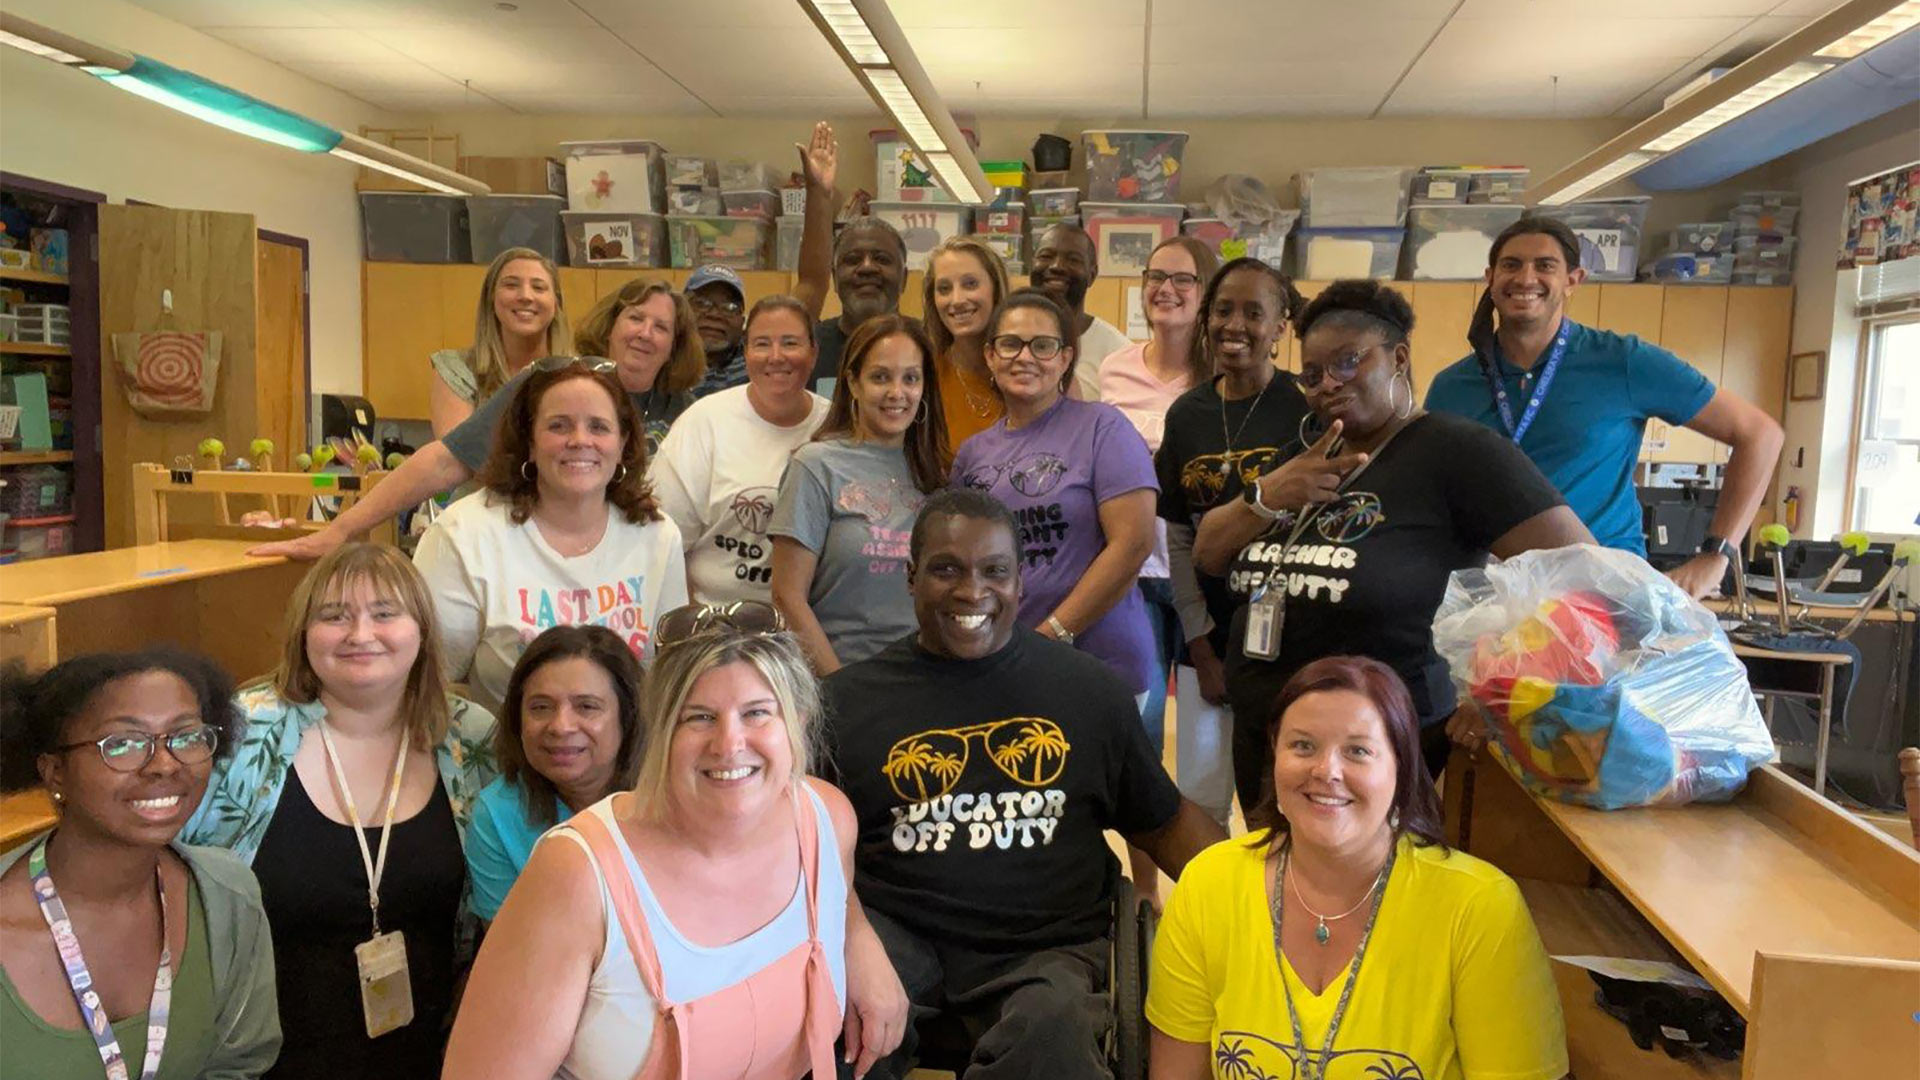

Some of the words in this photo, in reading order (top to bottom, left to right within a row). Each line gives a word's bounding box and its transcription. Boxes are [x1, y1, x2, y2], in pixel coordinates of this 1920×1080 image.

[609, 225, 629, 238] NOV
[1598, 234, 1618, 247] APR
[1019, 522, 1069, 543] ANT
[715, 534, 763, 559] SPED
[518, 588, 592, 627] LAST
[597, 576, 644, 613] DAY
[892, 822, 956, 852] OFF
[968, 817, 1058, 849] DUTY
